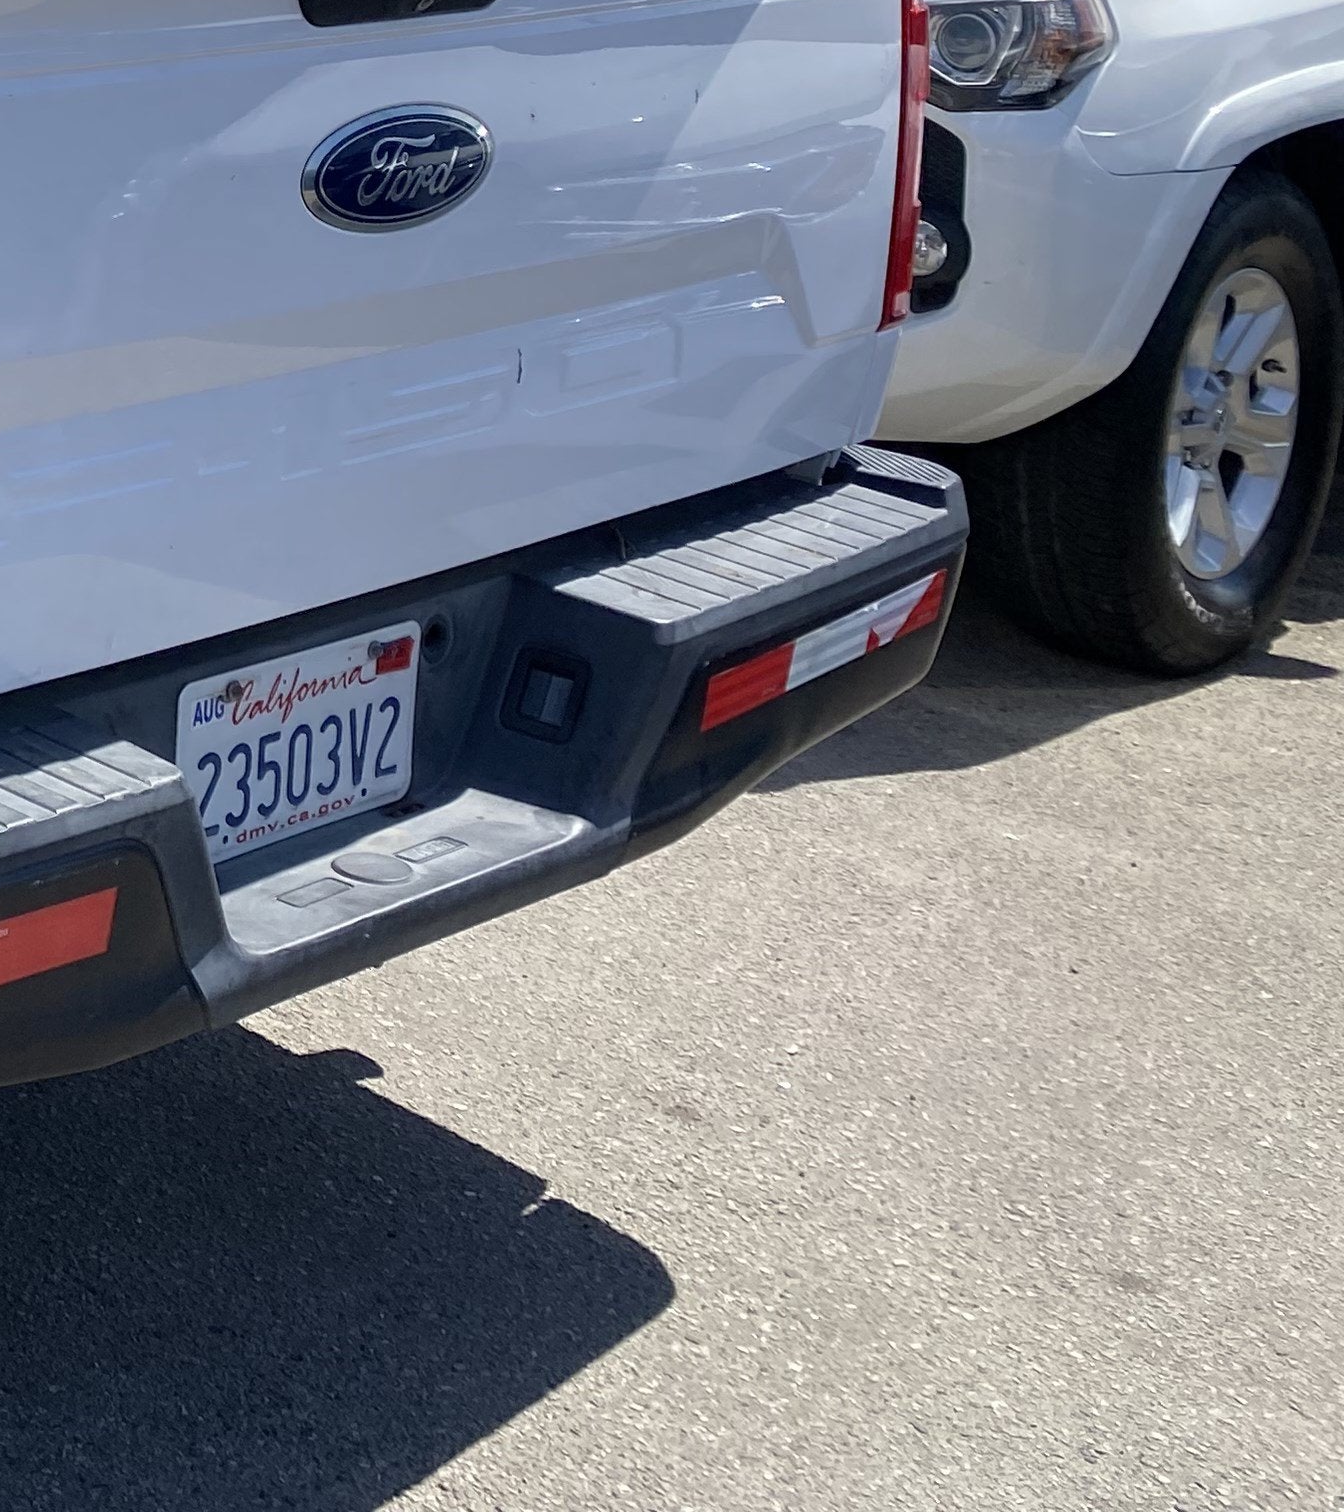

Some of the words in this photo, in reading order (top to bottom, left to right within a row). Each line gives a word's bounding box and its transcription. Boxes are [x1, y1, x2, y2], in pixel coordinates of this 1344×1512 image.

[357, 133, 460, 207] Ford
[192, 695, 225, 728] AUG
[231, 666, 378, 726] California
[196, 695, 401, 838] 23503V2
[235, 794, 356, 845] dmv.ca.gov
